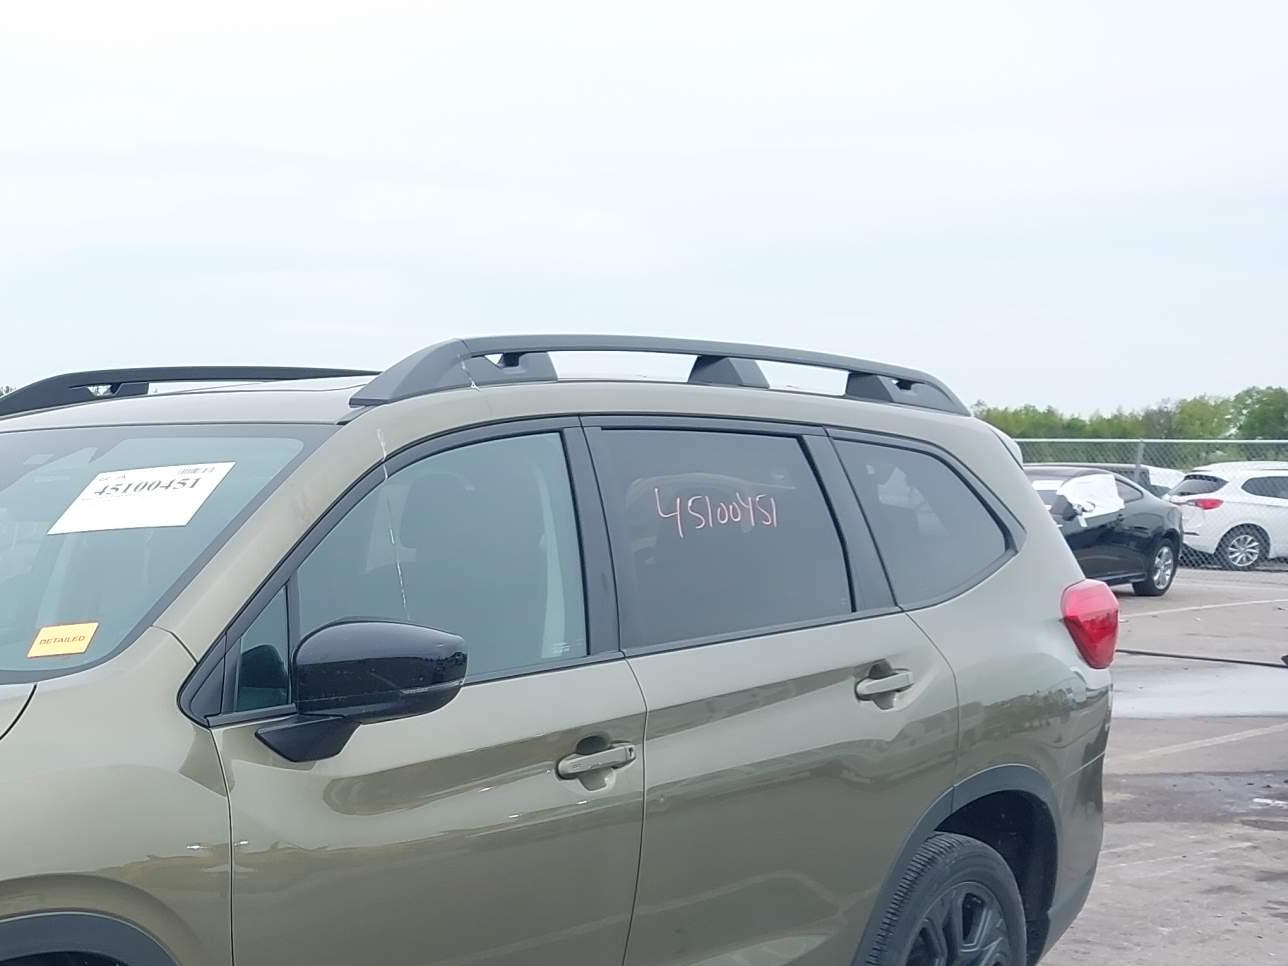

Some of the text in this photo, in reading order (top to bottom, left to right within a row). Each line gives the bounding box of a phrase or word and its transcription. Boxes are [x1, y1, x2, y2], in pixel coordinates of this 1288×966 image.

[94, 478, 202, 496] 45100451
[654, 487, 778, 538] 45100451
[40, 635, 86, 645] DETAILED
